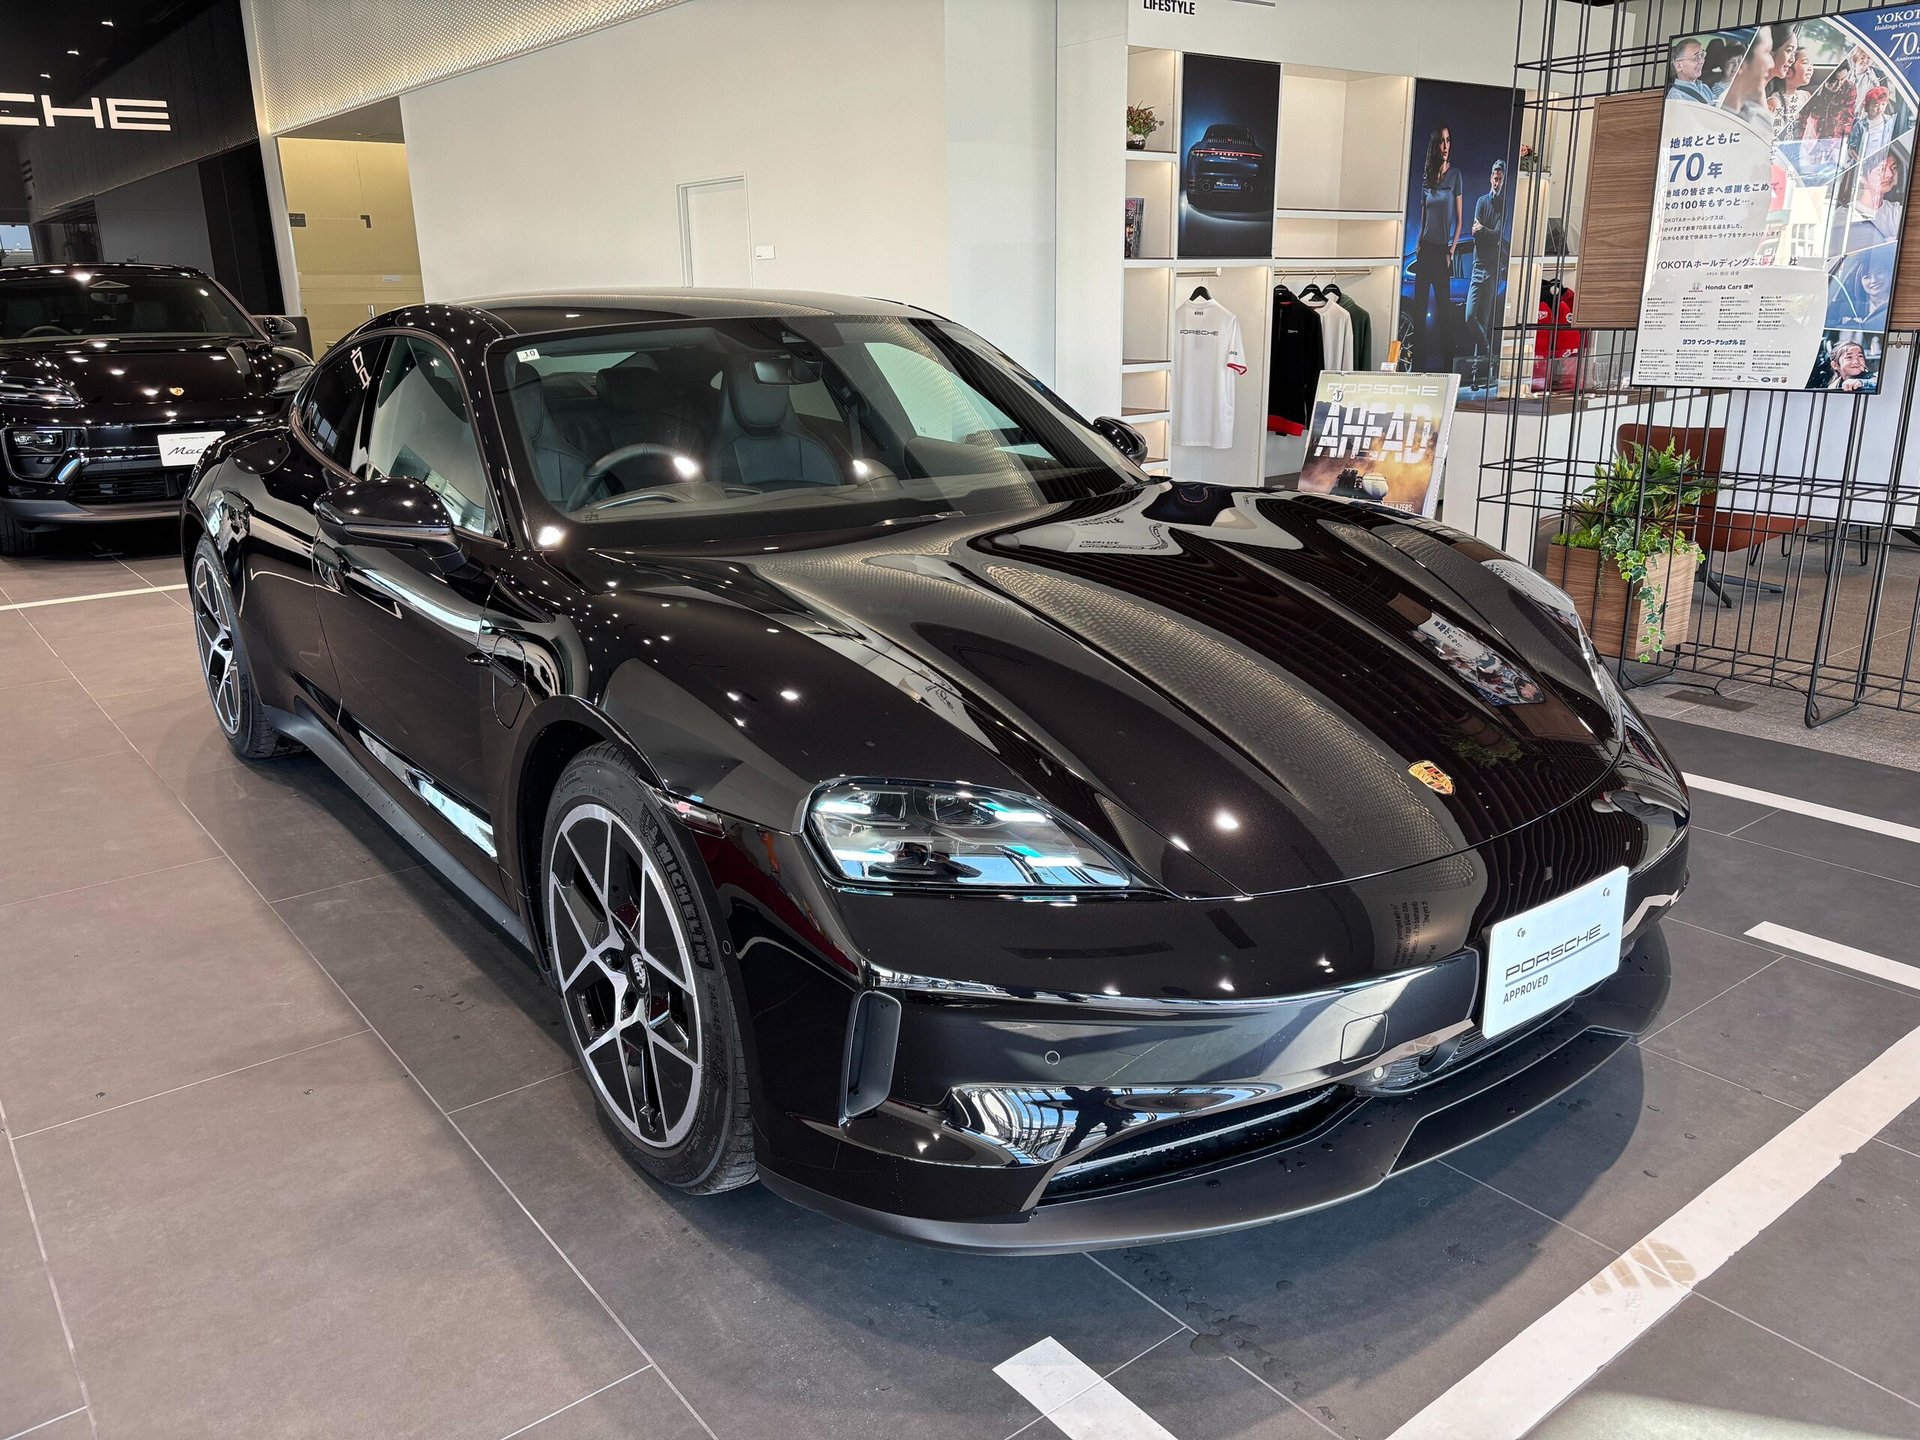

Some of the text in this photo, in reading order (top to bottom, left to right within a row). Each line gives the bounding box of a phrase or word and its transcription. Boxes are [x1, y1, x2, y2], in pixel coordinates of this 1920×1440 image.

[1143, 0, 1195, 15] LIFESTYLE
[1669, 132, 1741, 149] 地域とともに
[1179, 329, 1219, 337] PORSCHE
[1326, 382, 1440, 397] PORSCHE
[1313, 402, 1433, 464] AHEAD
[656, 841, 710, 964] MICHELIN
[1505, 923, 1602, 981] PORSCHE
[1502, 973, 1550, 1006] APPROVED
